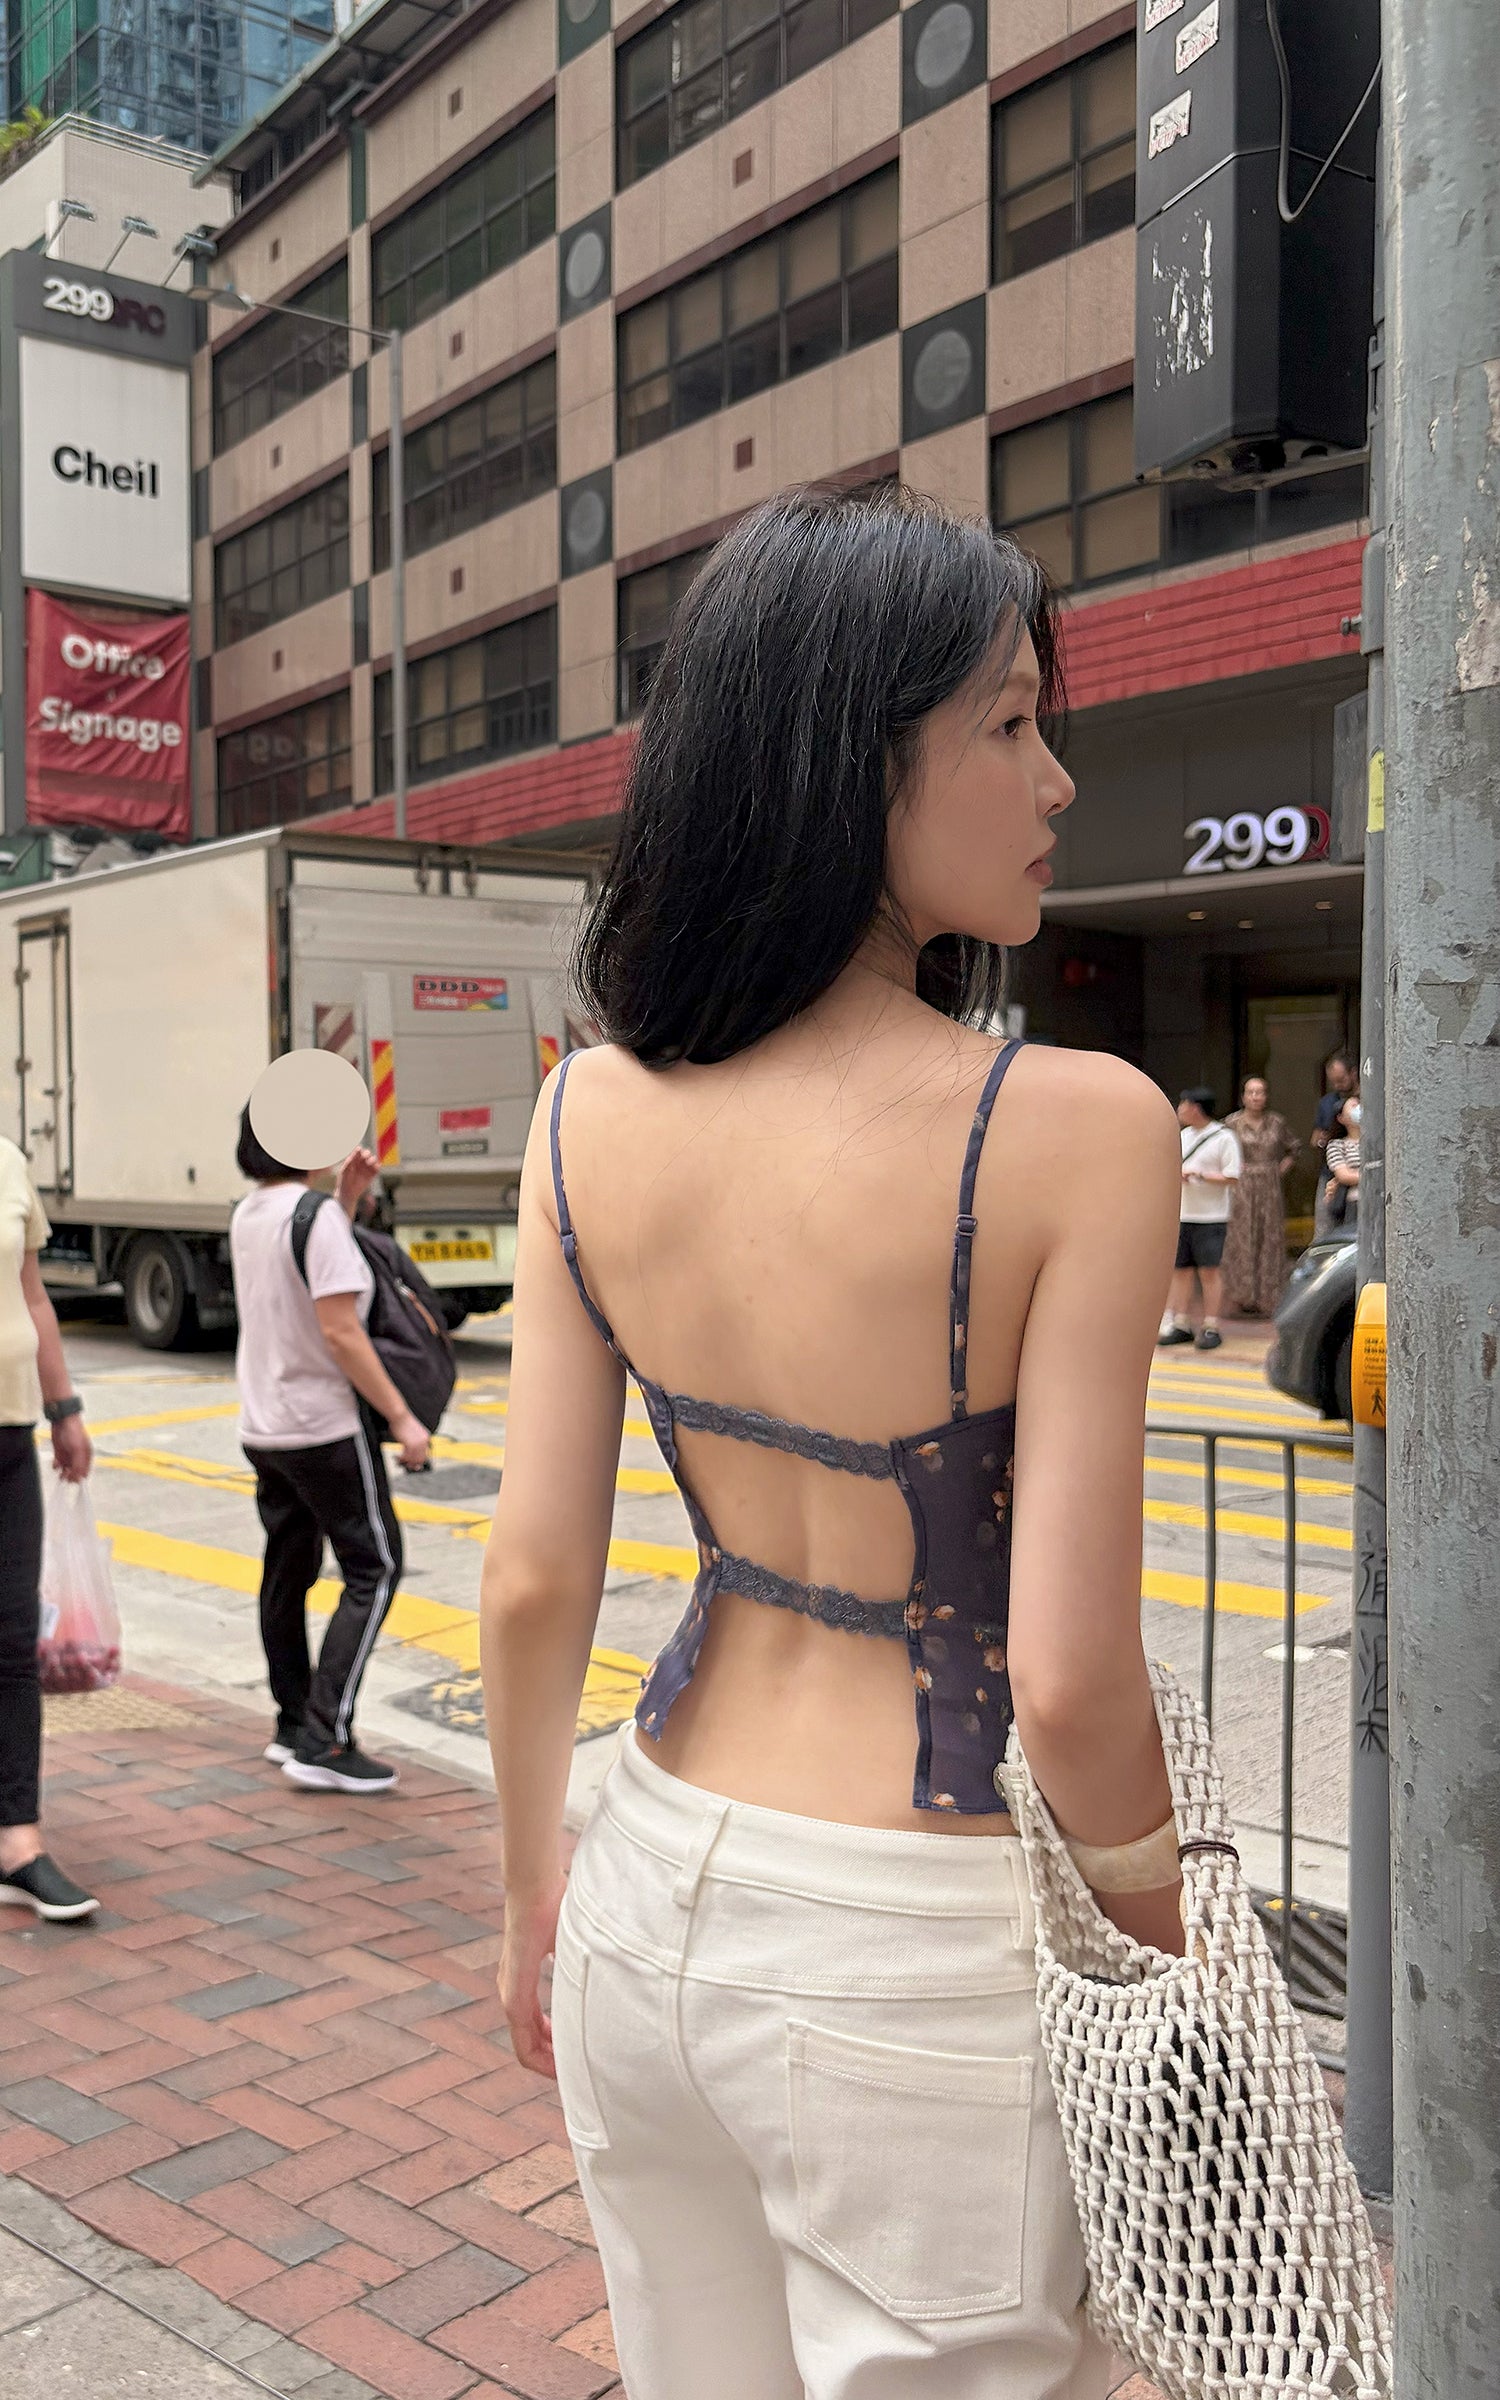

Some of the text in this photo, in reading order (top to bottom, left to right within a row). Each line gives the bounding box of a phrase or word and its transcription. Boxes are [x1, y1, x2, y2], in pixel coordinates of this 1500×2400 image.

[53, 445, 159, 499] Cheil
[61, 634, 166, 680] Office
[39, 696, 183, 752] Signage
